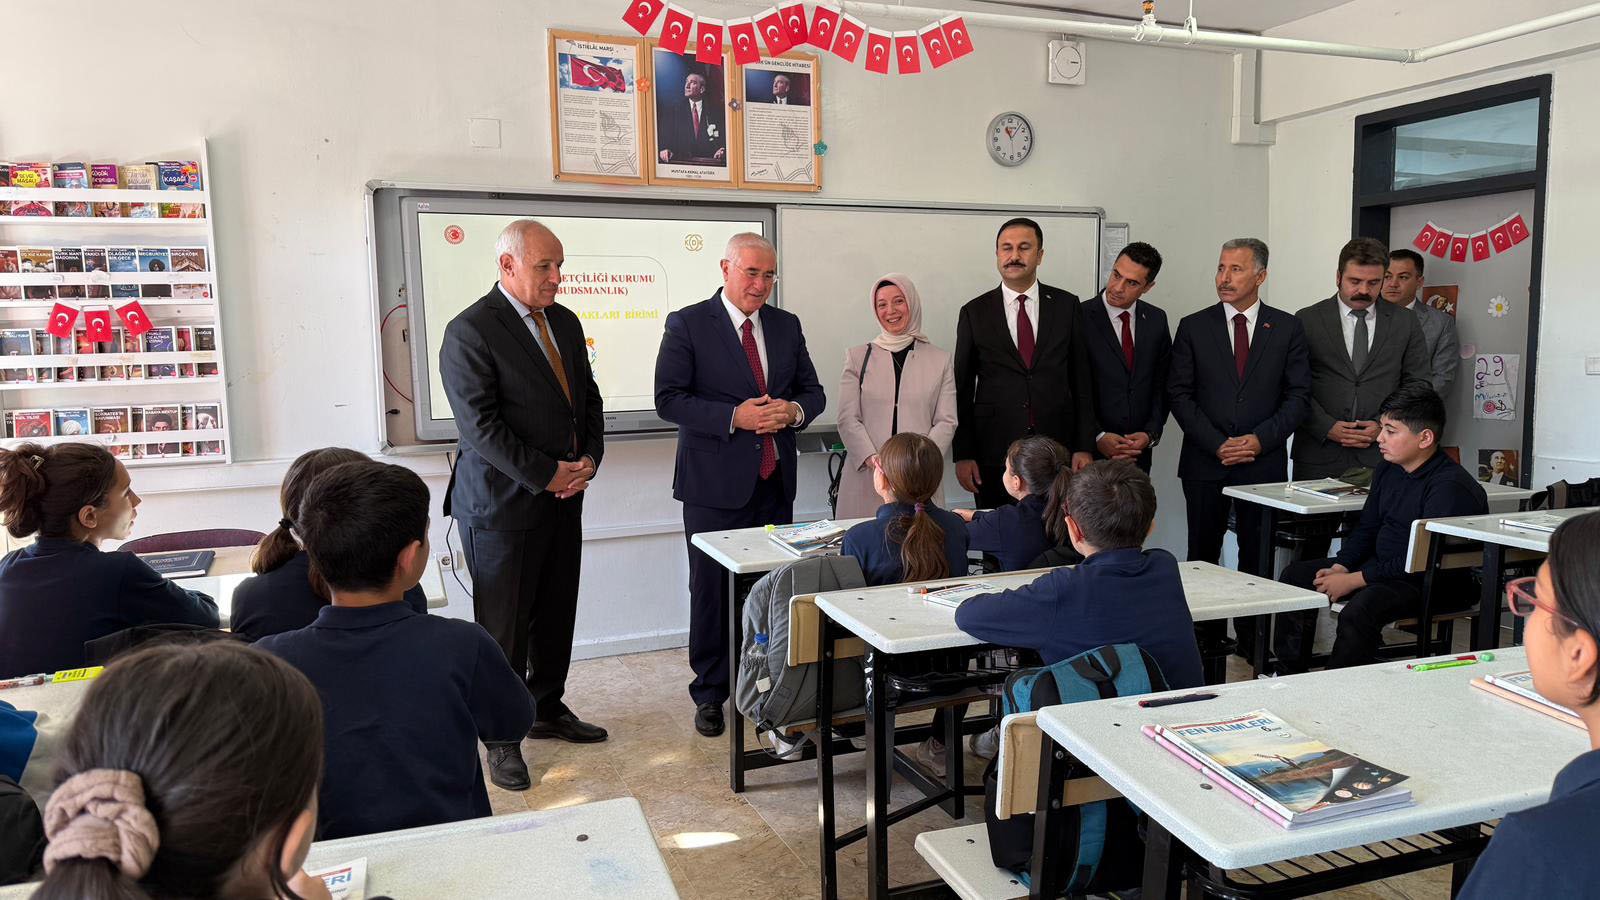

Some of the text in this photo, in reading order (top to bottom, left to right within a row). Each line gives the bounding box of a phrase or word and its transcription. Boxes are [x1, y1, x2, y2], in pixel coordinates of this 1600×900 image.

[560, 273, 655, 284] ETÇİLİĞİ KURUMU
[557, 286, 628, 295] BUDSMANLIK)
[1476, 355, 1504, 380] 29
[1177, 727, 1207, 736] FEN
